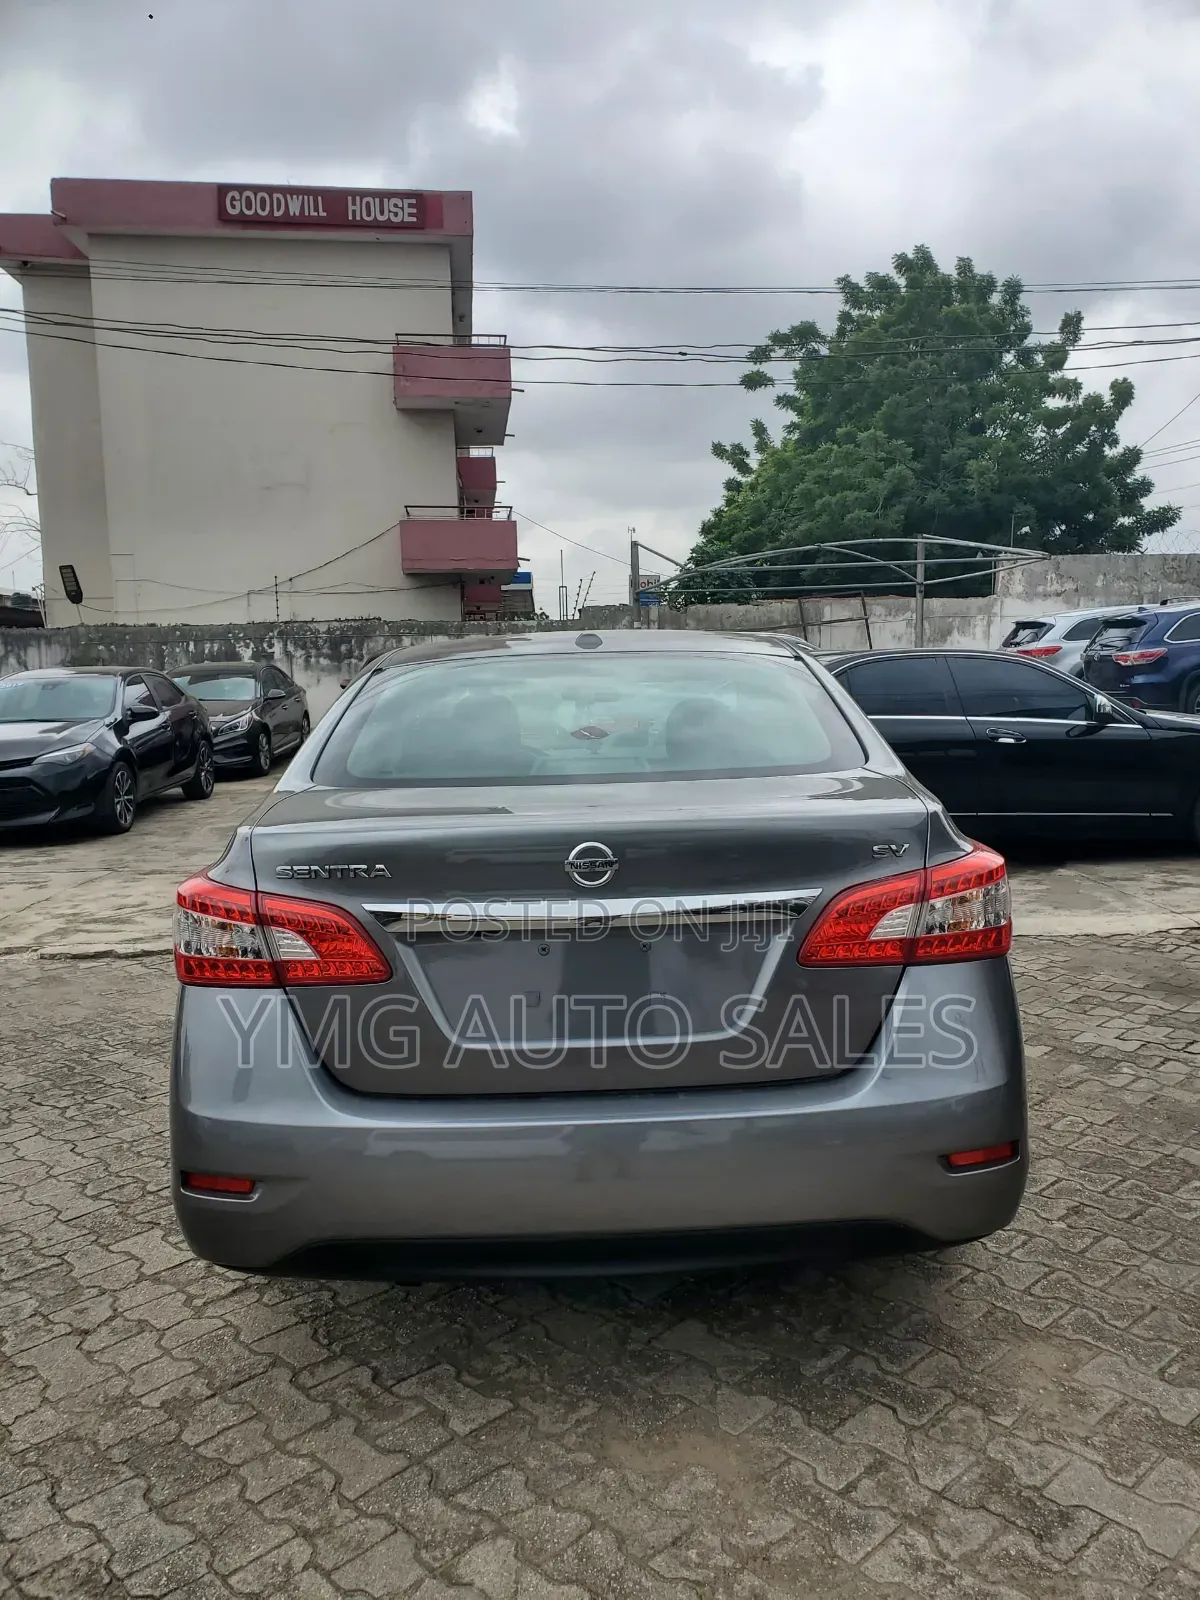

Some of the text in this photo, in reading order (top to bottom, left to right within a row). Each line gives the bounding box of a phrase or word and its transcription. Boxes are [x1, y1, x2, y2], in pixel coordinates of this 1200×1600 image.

[225, 190, 418, 222] GOODWILL HOUSE
[872, 843, 910, 859] SV
[275, 864, 392, 879] SENTRA
[570, 860, 614, 870] NISSAN
